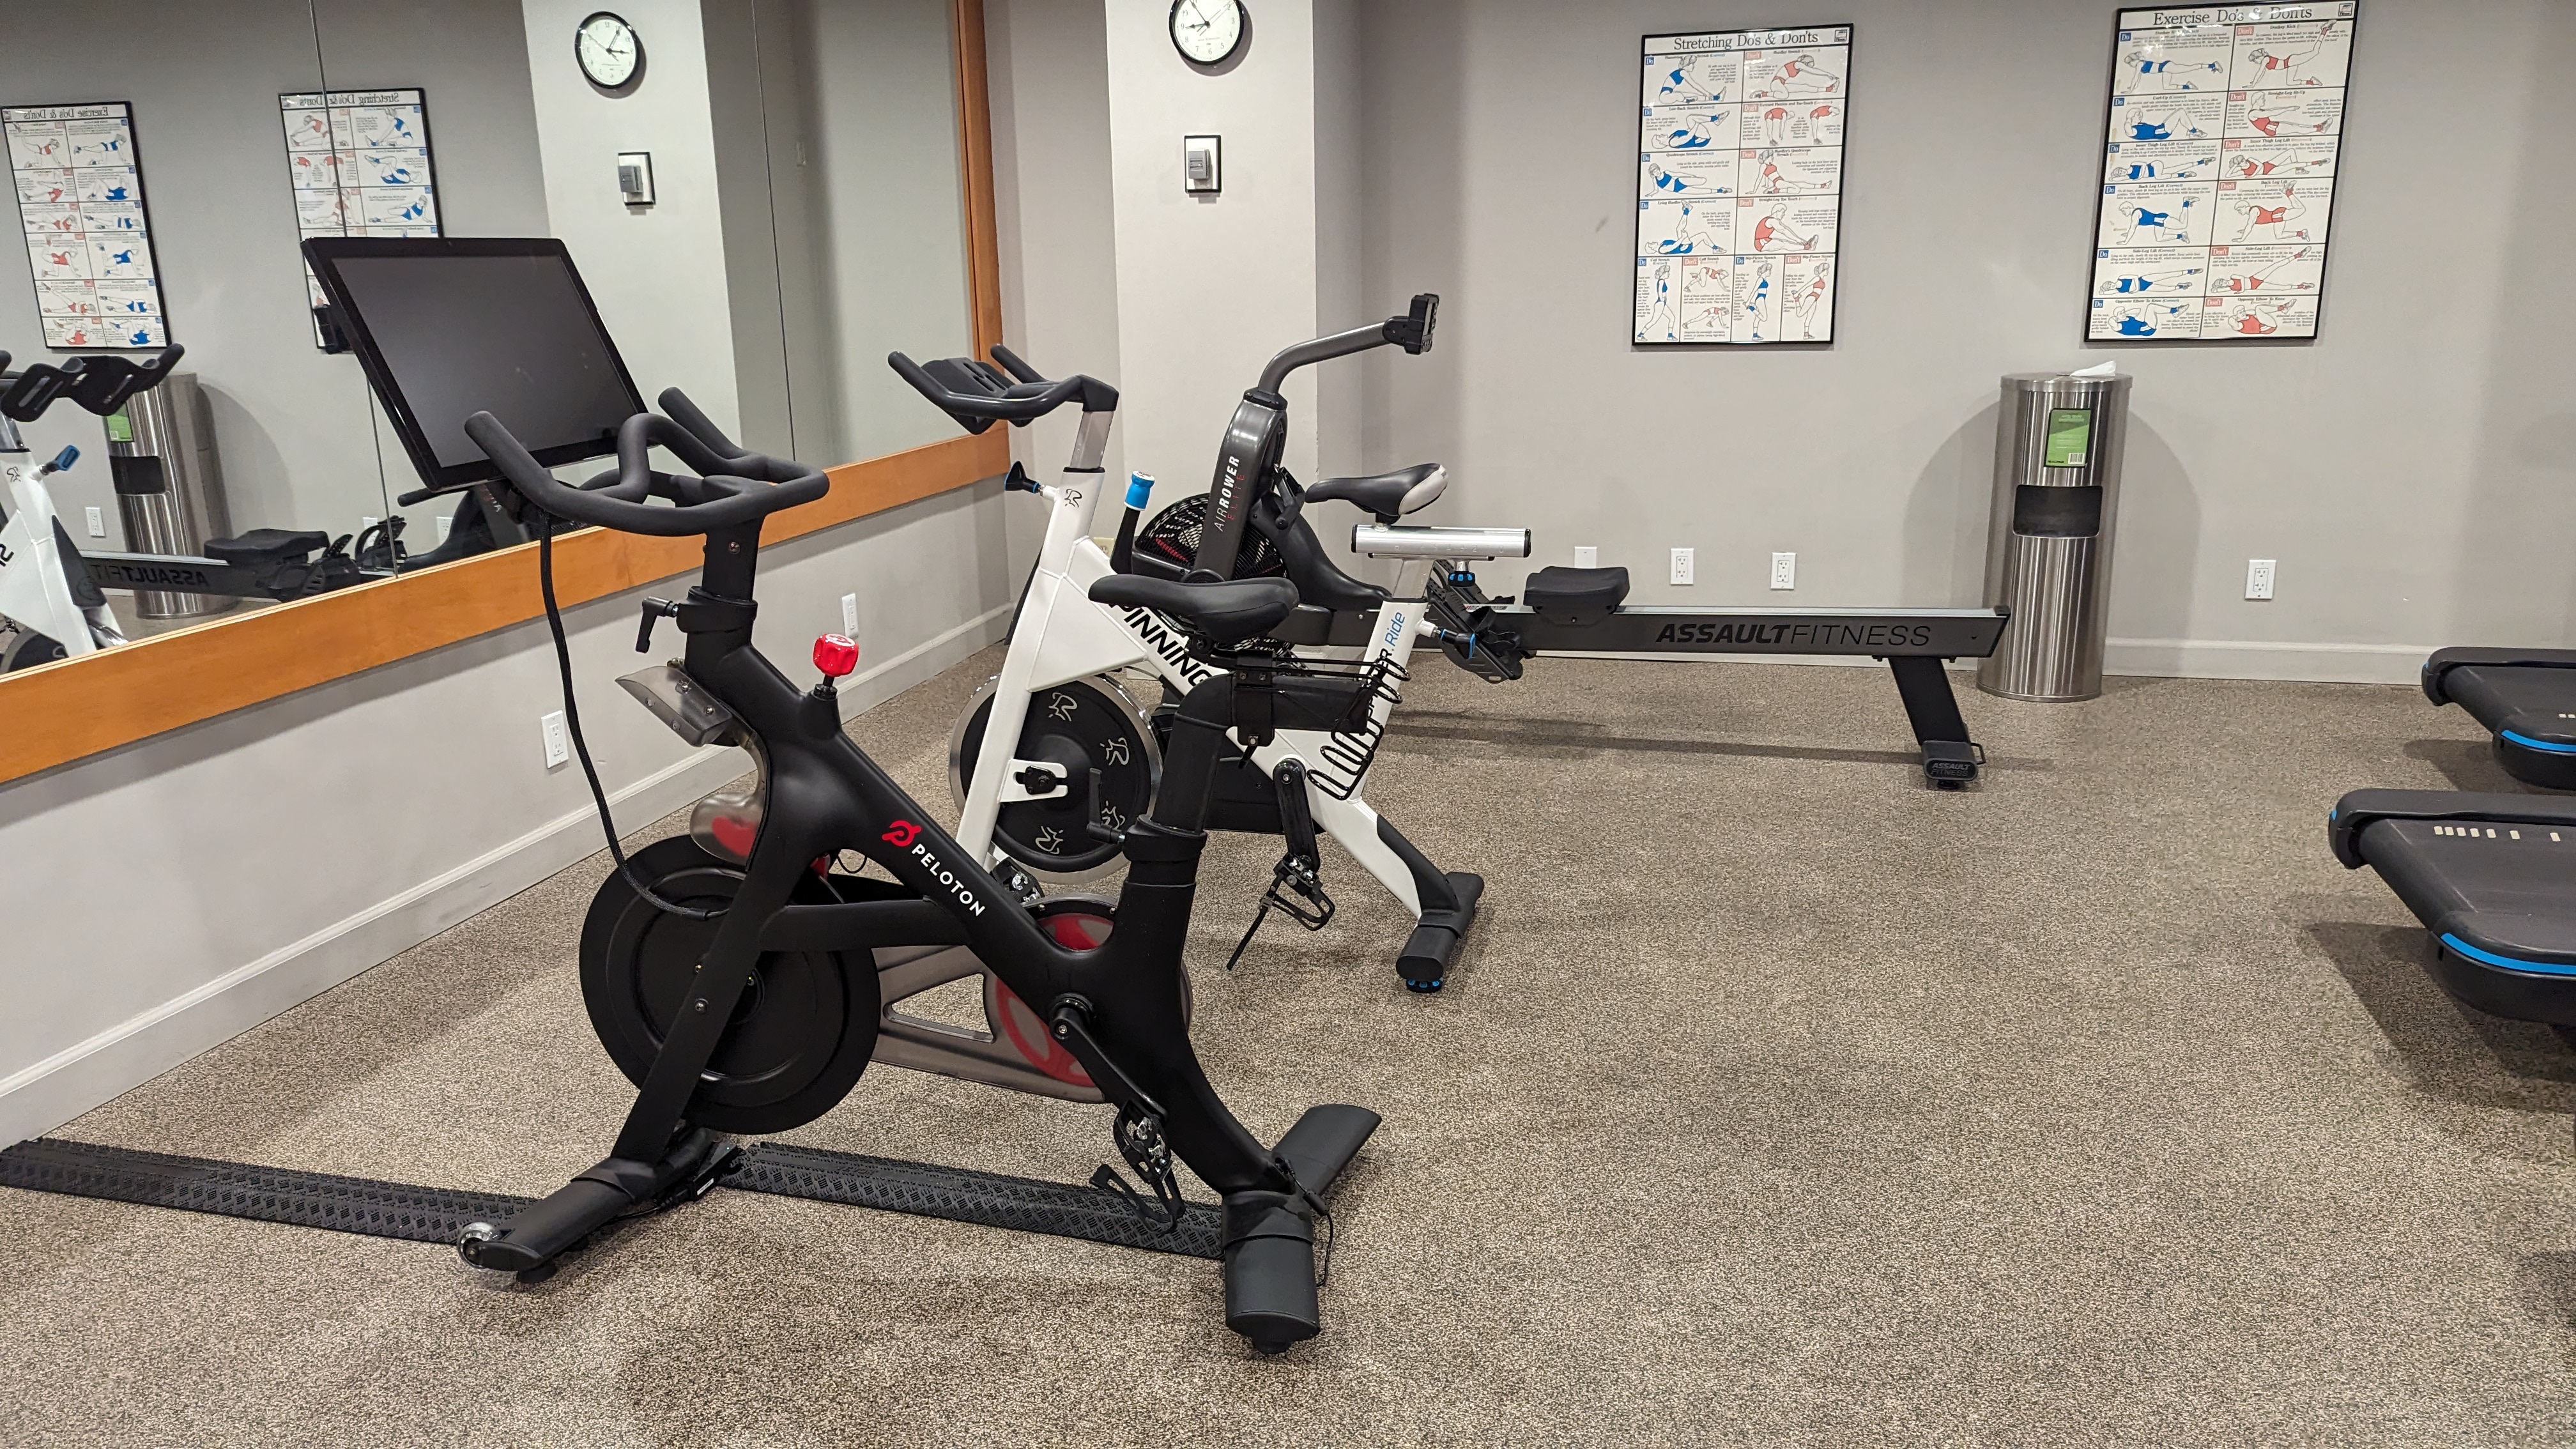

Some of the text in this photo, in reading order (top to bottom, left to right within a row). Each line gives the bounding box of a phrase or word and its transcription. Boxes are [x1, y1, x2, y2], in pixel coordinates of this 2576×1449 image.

[2153, 11, 2210, 26] Exercise
[2216, 8, 2244, 22] Do's
[2269, 5, 2312, 20] Don'ts
[1674, 31, 1818, 50] Stretching Do's & Don'ts
[1214, 456, 1239, 532] AIRROWER
[1384, 611, 1406, 647] Ride
[1109, 603, 1213, 687] INNING
[1931, 769, 1968, 777] FITNESS
[1932, 762, 1970, 770] ASSAULT
[912, 843, 985, 917] PELOTON
